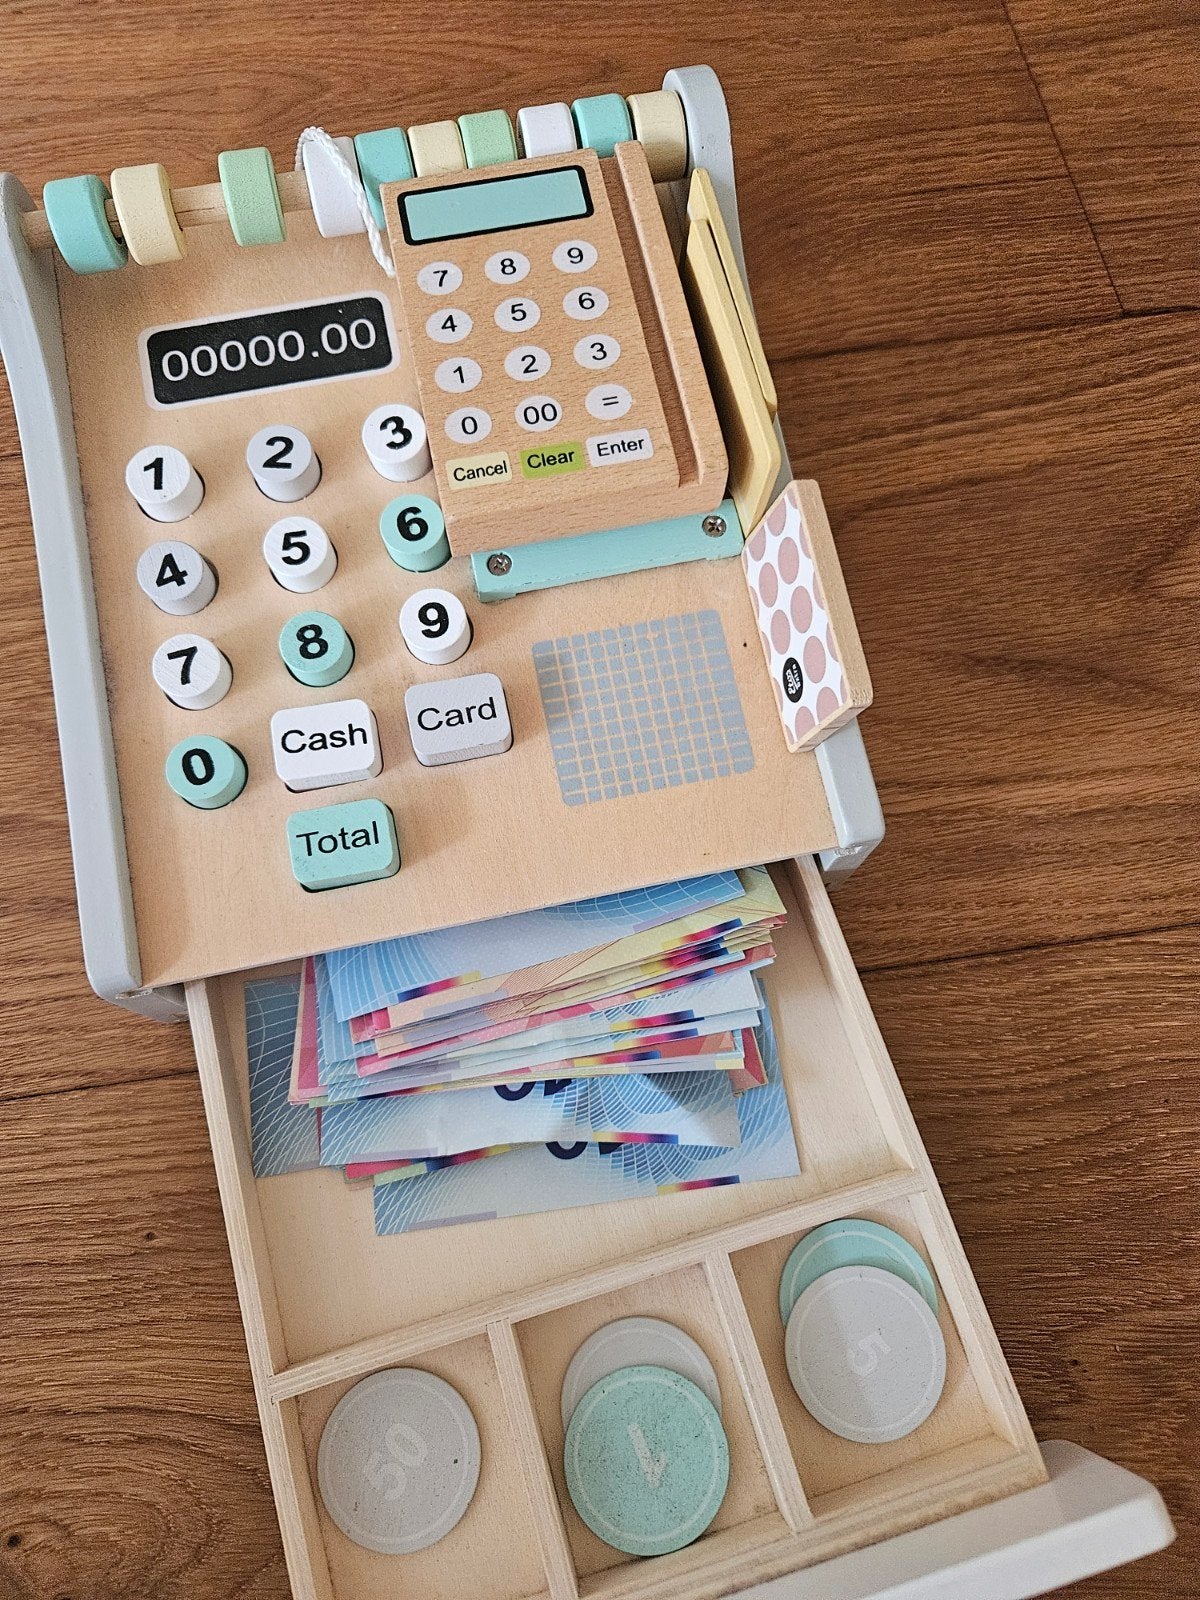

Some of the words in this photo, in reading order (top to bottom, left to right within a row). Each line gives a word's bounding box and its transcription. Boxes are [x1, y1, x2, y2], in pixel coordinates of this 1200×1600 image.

[501, 258, 516, 275] 8
[567, 248, 583, 264] 9
[433, 270, 448, 287] 7
[511, 303, 526, 321] 5
[579, 293, 594, 309] 6
[442, 315, 457, 332] 4
[162, 318, 376, 381] 00000.00
[521, 355, 538, 373] 2
[591, 343, 607, 360] 3
[453, 366, 464, 383] 1
[524, 403, 557, 424] 00
[602, 396, 619, 406] =
[380, 416, 412, 449] 3
[462, 417, 477, 434] 0
[263, 436, 293, 469] 2
[527, 452, 574, 468] Clear
[597, 439, 644, 456] Enter
[144, 458, 163, 490] 1
[454, 460, 507, 481] Cancel
[397, 507, 428, 541] 6
[282, 530, 310, 565] 5
[156, 553, 188, 587] 4
[418, 602, 449, 638] 9
[296, 624, 328, 659] 8
[167, 646, 197, 685] 7
[418, 697, 497, 730] Card
[281, 724, 367, 753] Cash
[182, 748, 214, 785] 0
[296, 821, 379, 856] Total
[845, 1331, 892, 1378] 5
[363, 1420, 429, 1500] 50
